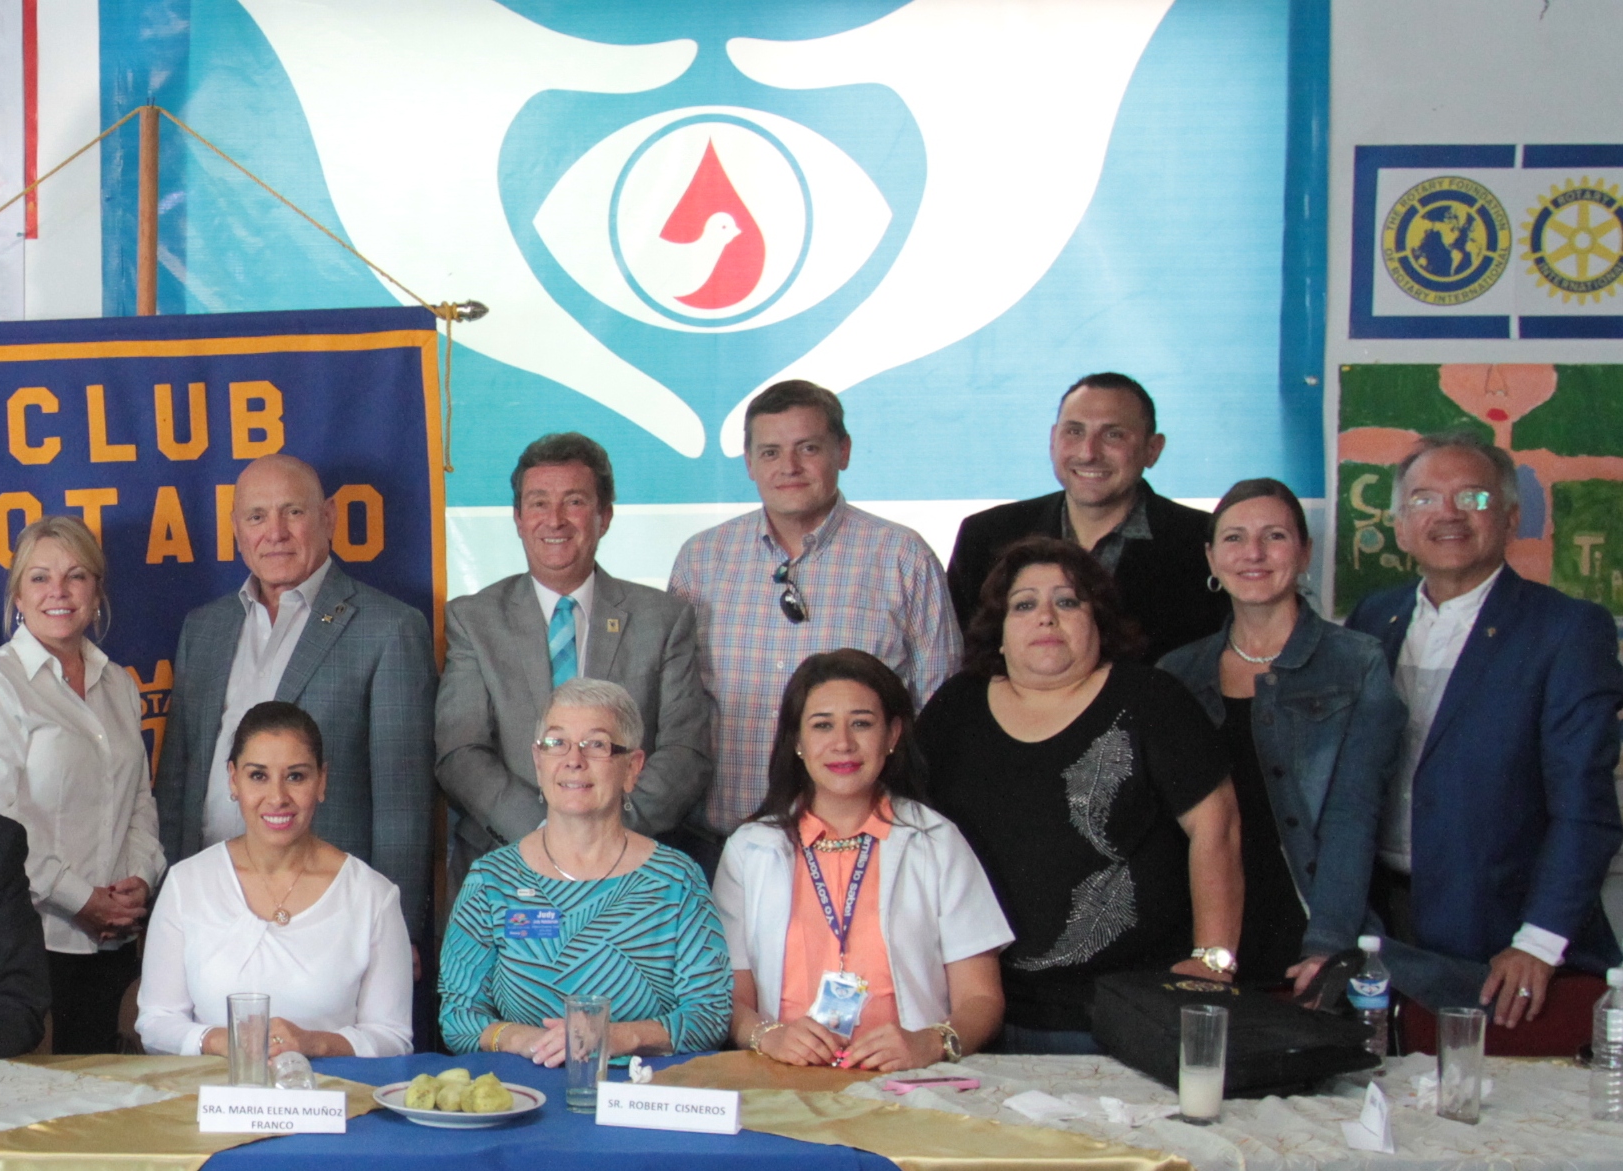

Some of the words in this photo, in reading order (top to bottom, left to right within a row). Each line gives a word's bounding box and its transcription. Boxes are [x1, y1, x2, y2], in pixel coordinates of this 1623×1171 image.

[1557, 190, 1611, 208] ROTARY
[7, 380, 285, 465] CLUB
[852, 870, 864, 881] lo
[816, 881, 830, 905] soy
[537, 910, 556, 920] Judy
[824, 905, 835, 926] Yo
[202, 1104, 225, 1114] SRA.
[228, 1105, 264, 1115] MARIA
[267, 1106, 299, 1116] ELENA
[302, 1106, 343, 1117] MUÑOZ
[607, 1099, 623, 1108] SR.
[629, 1100, 669, 1112] ROBERT
[675, 1104, 726, 1116] CISNEROS
[251, 1120, 294, 1130] FRANCO
